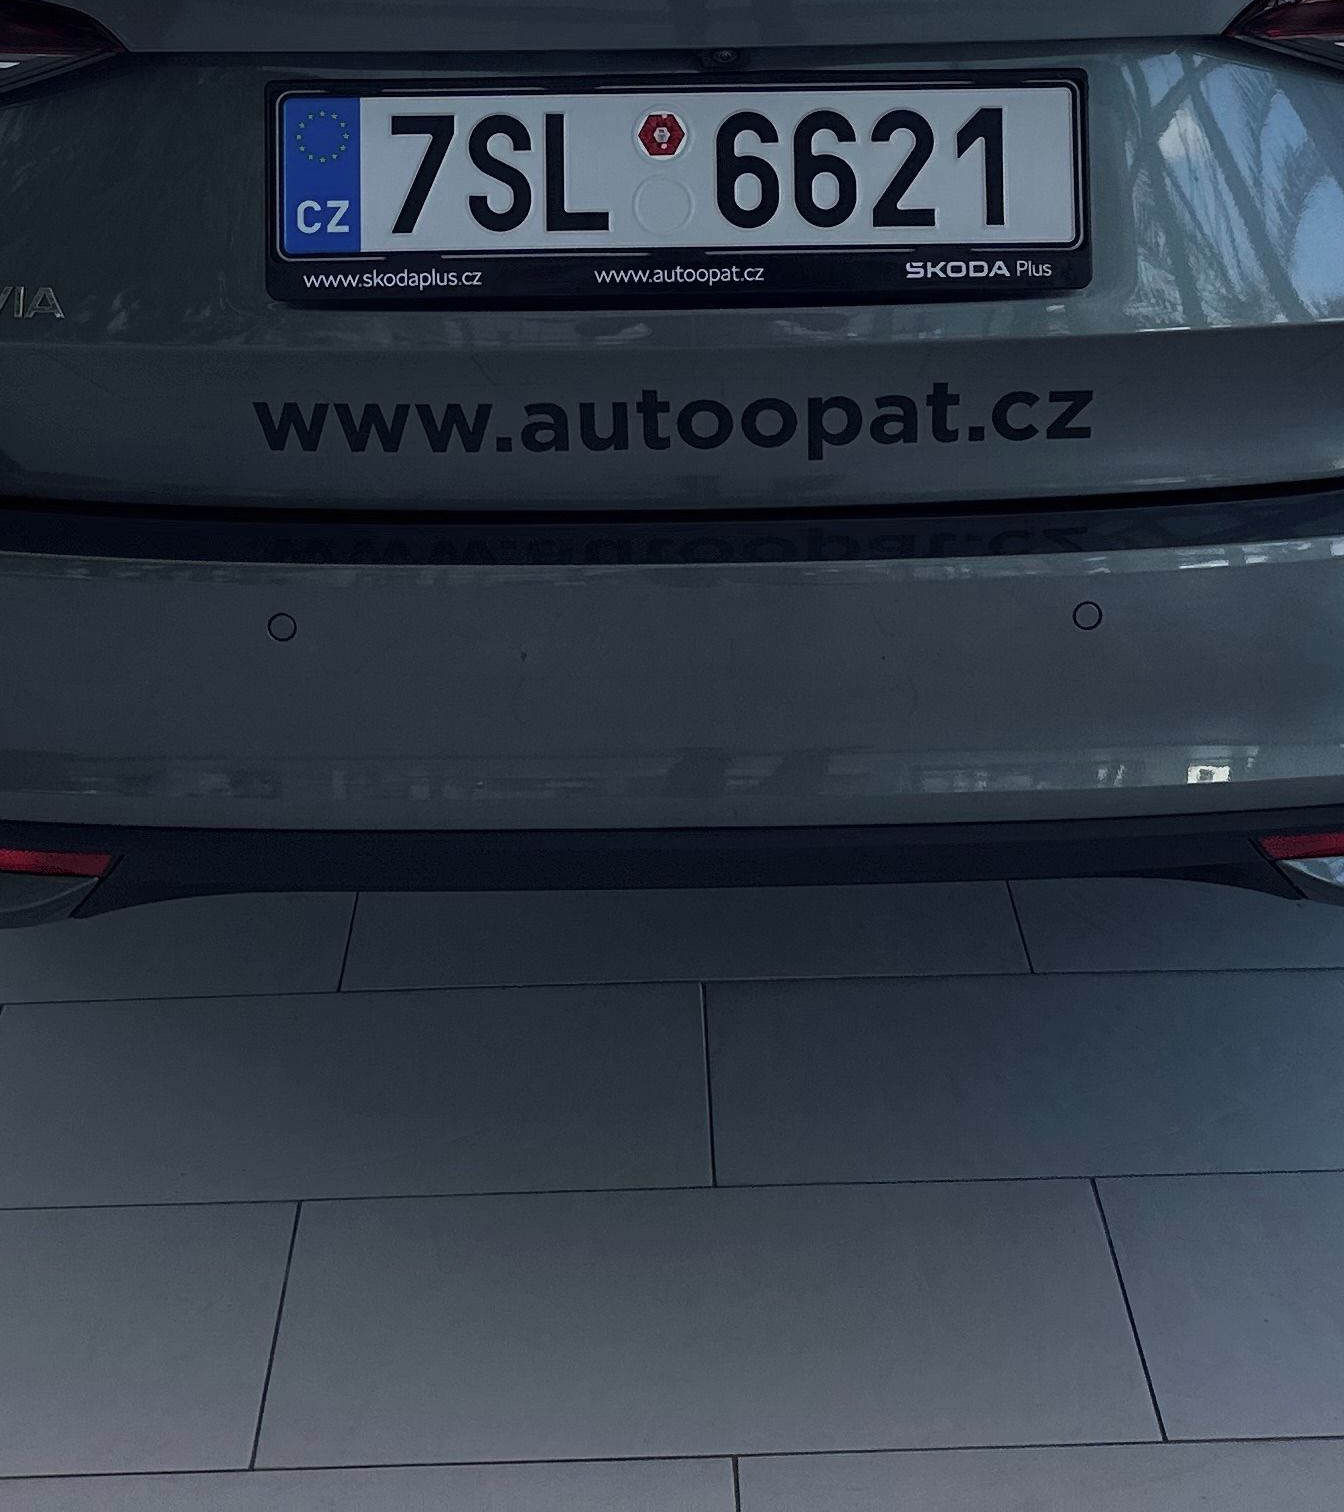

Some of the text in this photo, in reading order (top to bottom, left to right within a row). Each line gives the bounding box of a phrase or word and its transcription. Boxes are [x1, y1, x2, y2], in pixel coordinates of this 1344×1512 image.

[390, 107, 1006, 234] 7SL 6621
[296, 199, 350, 234] CZ
[302, 268, 483, 291] www.skodaplus.cz
[594, 264, 765, 287] www.autoopat.cz
[1016, 260, 1053, 277] Plus
[252, 381, 1094, 461] www.autoopat.cz
